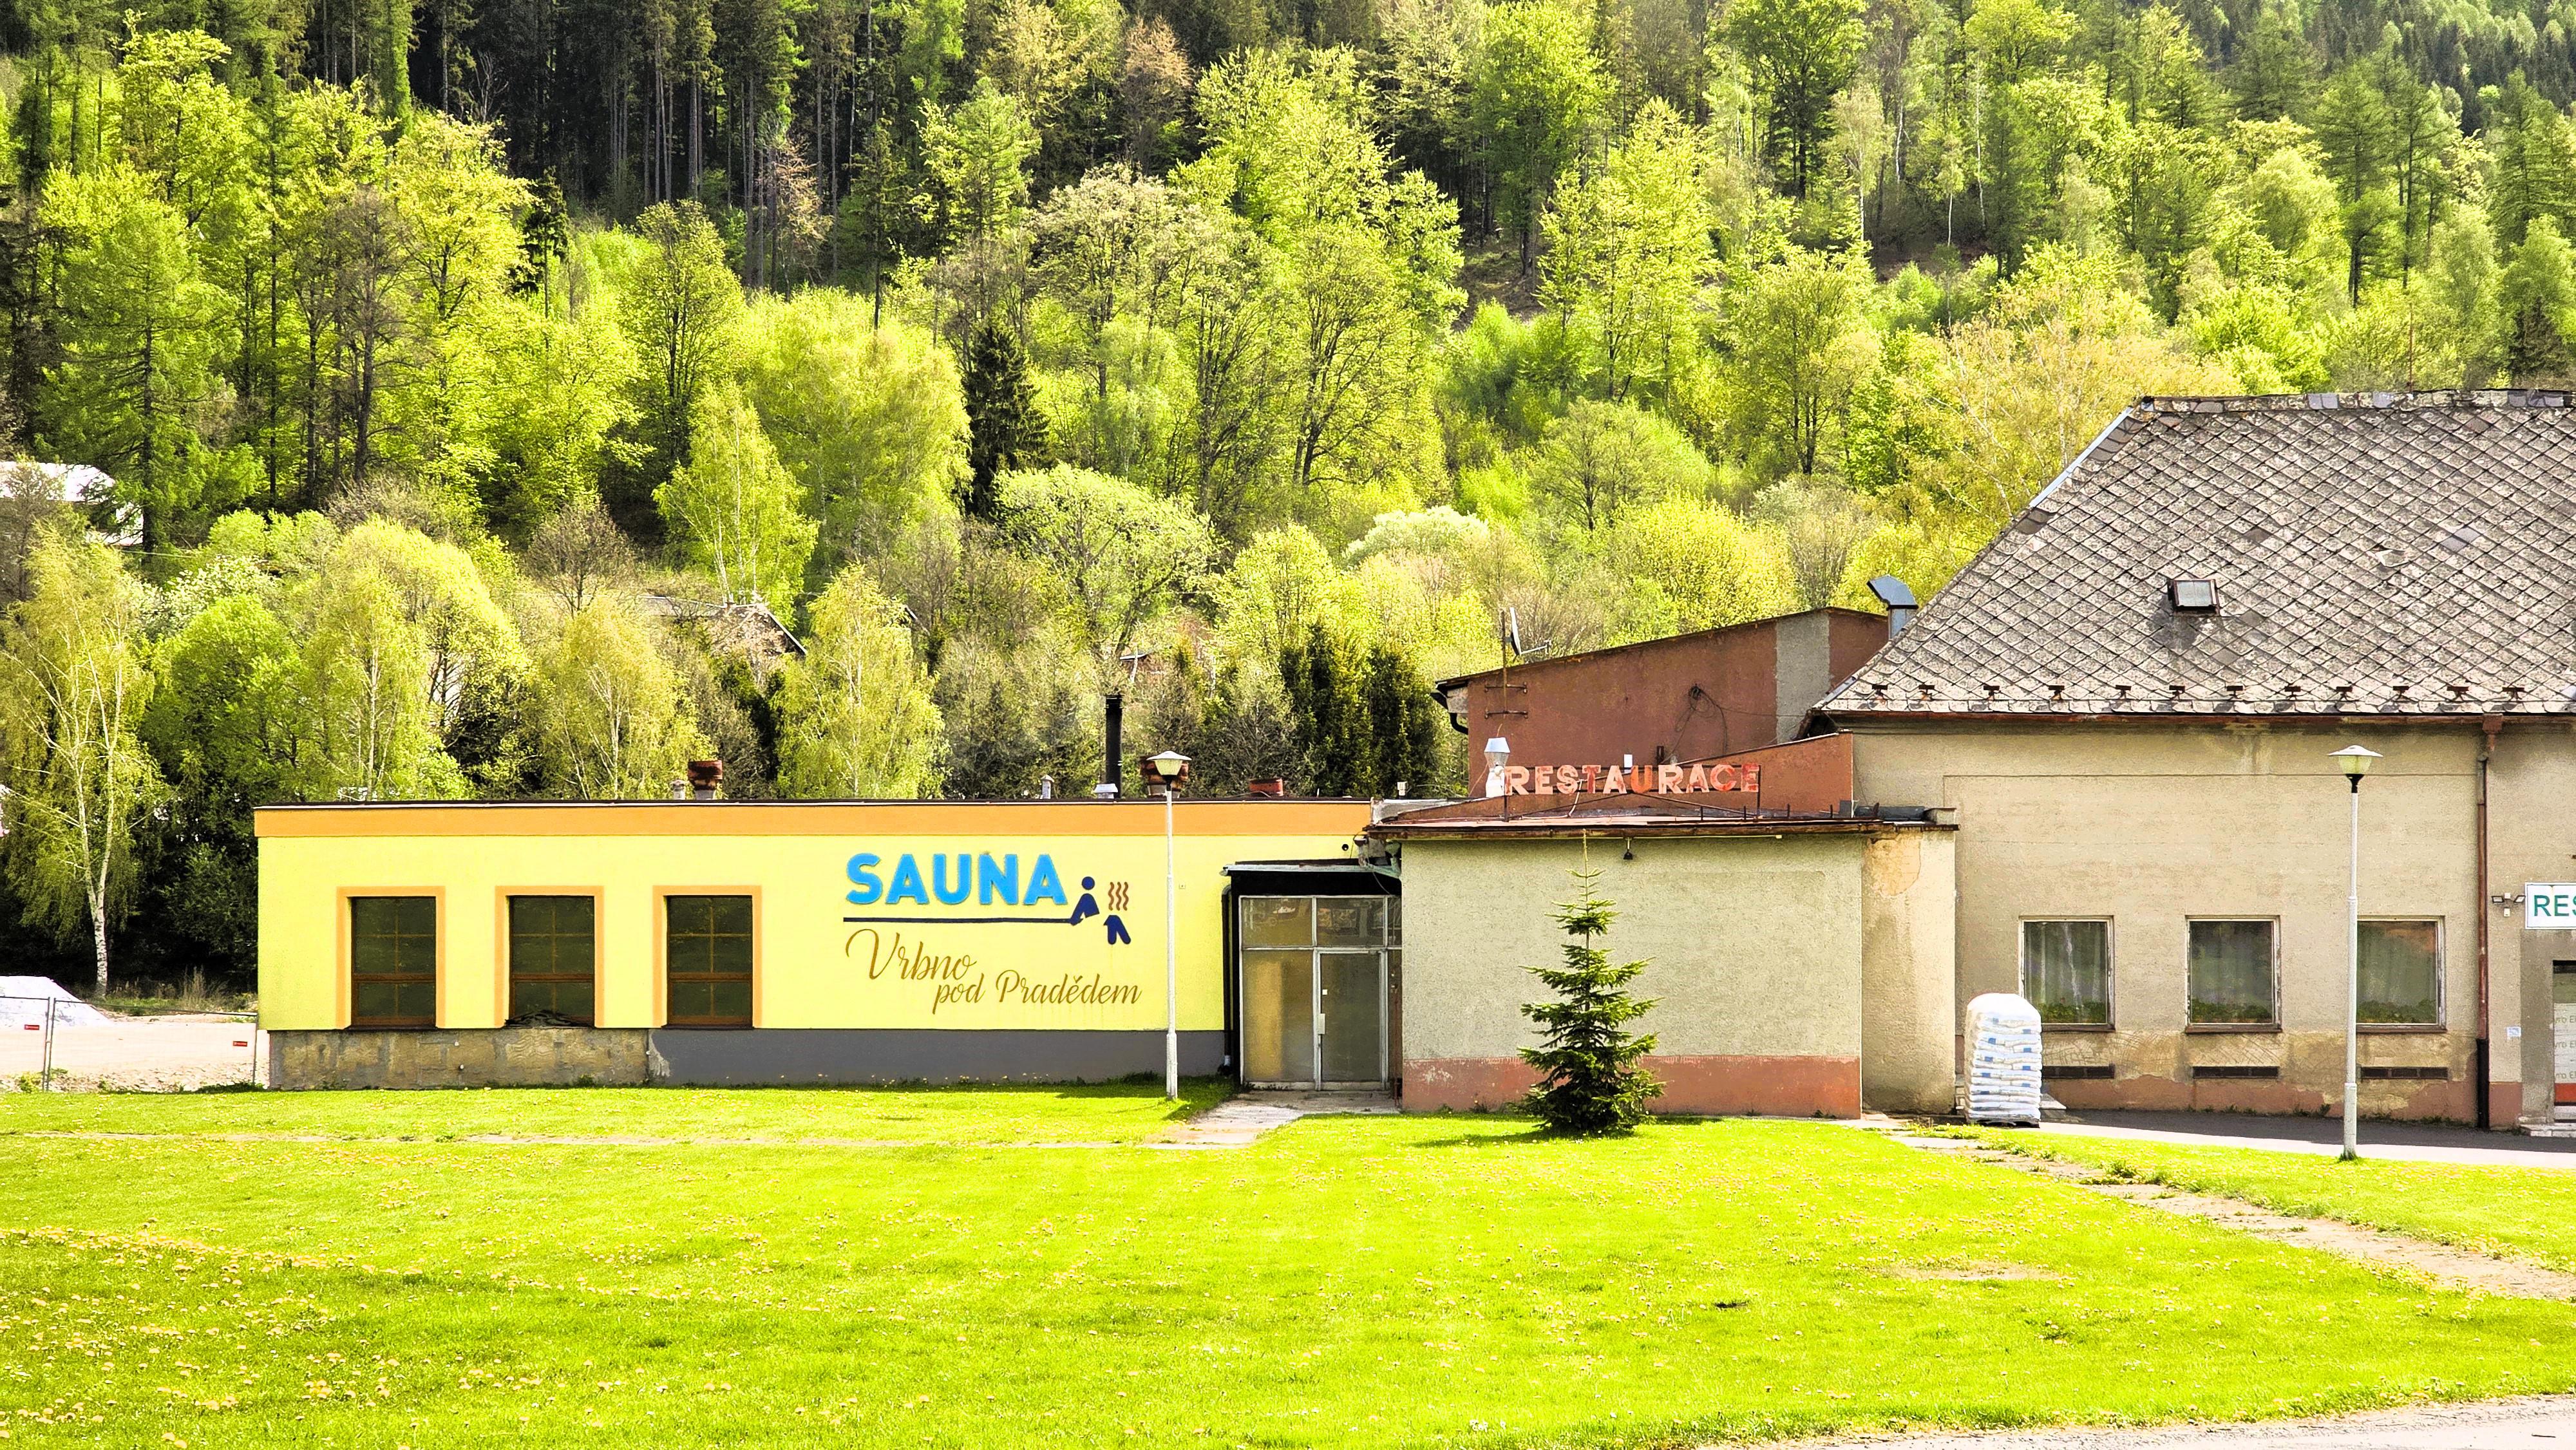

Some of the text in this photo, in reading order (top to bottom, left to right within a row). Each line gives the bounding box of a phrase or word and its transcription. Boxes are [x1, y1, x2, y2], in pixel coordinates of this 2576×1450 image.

[1504, 764, 1759, 795] RESTAURACE
[846, 853, 1068, 905] SAUNA
[2533, 894, 2576, 918] RE
[845, 928, 978, 981] Vrbno
[932, 969, 1142, 1015] pod Pradědem
